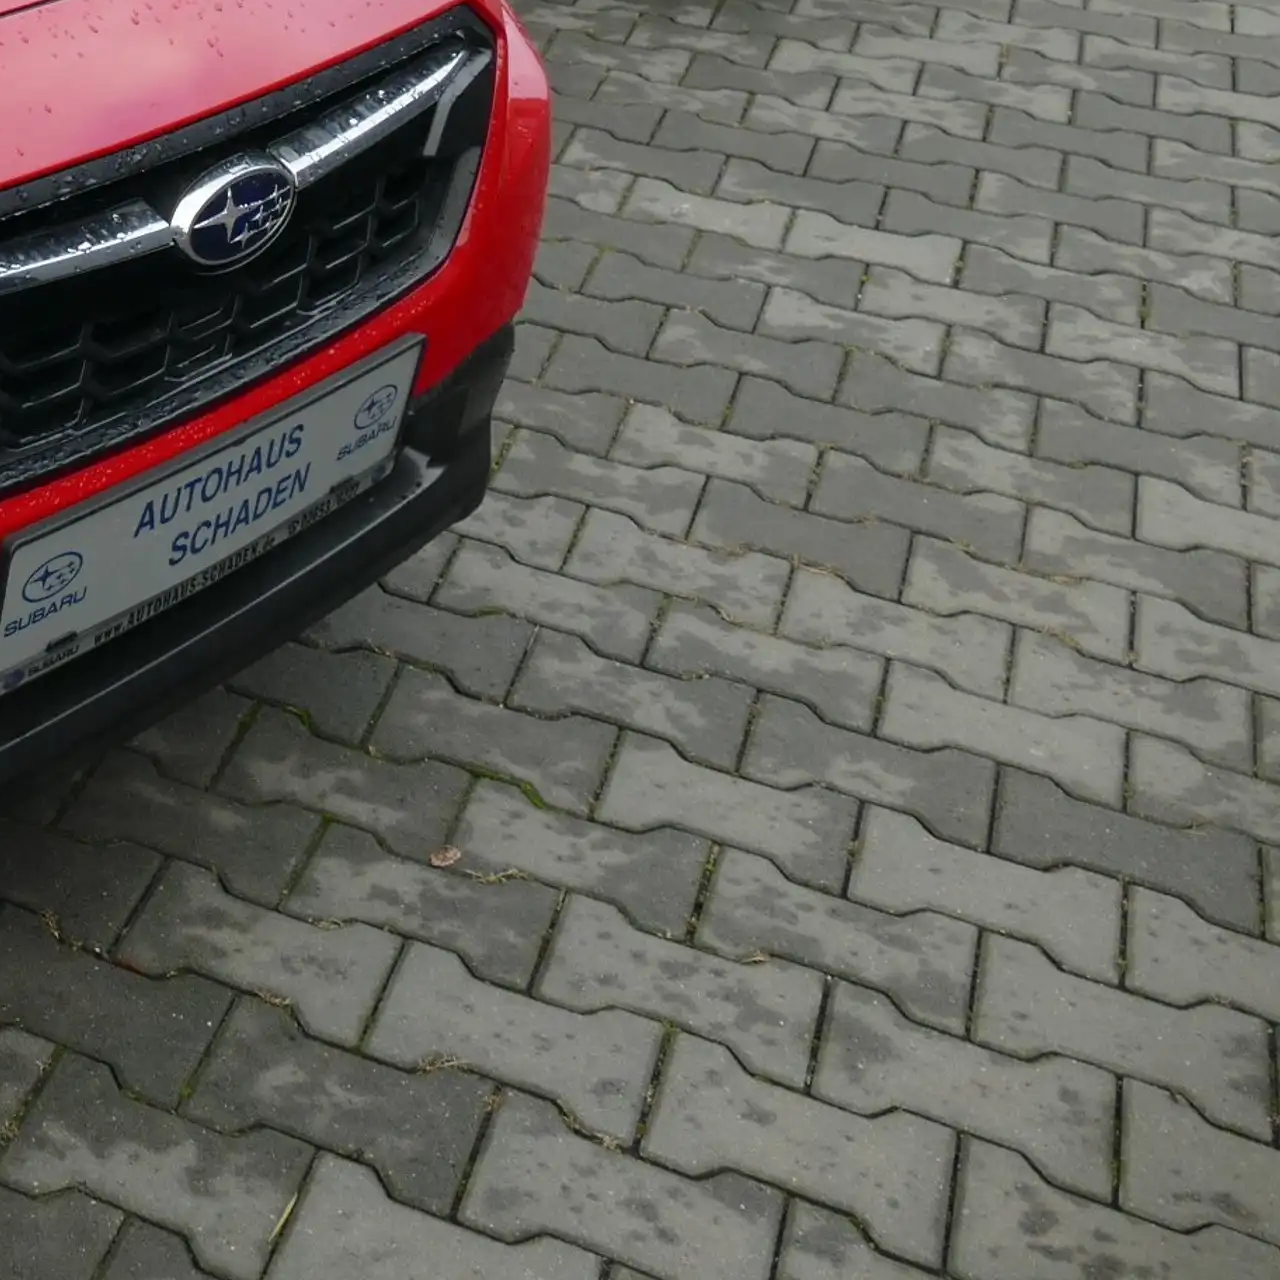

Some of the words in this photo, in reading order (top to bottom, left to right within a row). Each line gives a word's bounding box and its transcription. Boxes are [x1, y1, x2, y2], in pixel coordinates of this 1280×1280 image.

[336, 416, 397, 461] SUBARU
[134, 424, 304, 538] AUTOHAUS
[168, 461, 312, 566] SCHADEN
[4, 586, 88, 638] SUBARU
